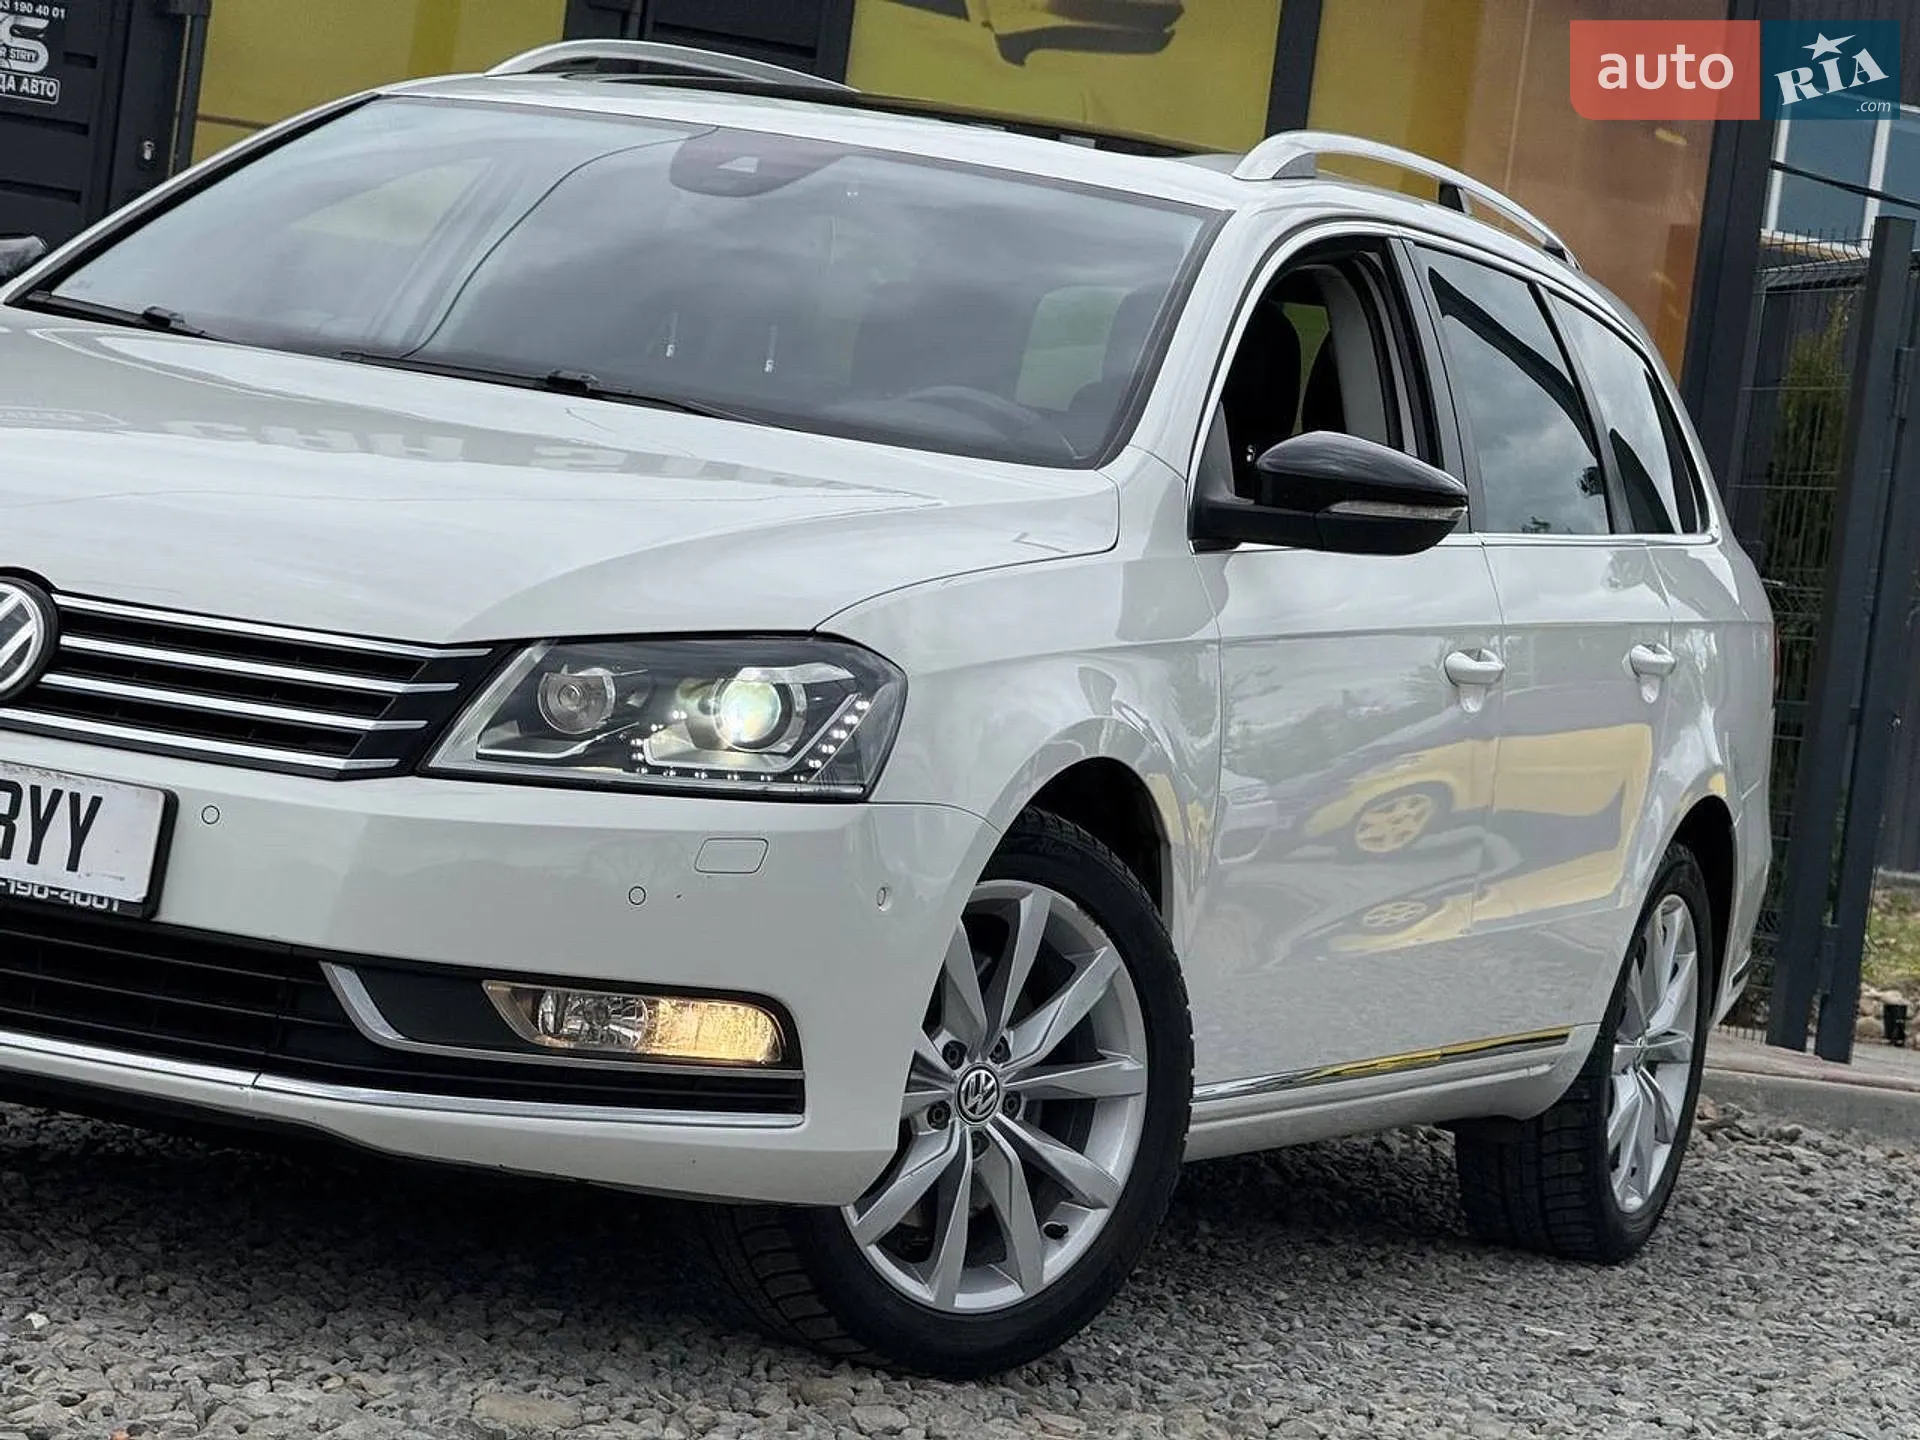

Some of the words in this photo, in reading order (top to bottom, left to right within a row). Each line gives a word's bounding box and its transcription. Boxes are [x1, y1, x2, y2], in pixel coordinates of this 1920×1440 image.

[14, 1, 33, 14] 190
[35, 5, 49, 16] 40
[52, 7, 66, 19] 01
[20, 78, 57, 97] АВТО
